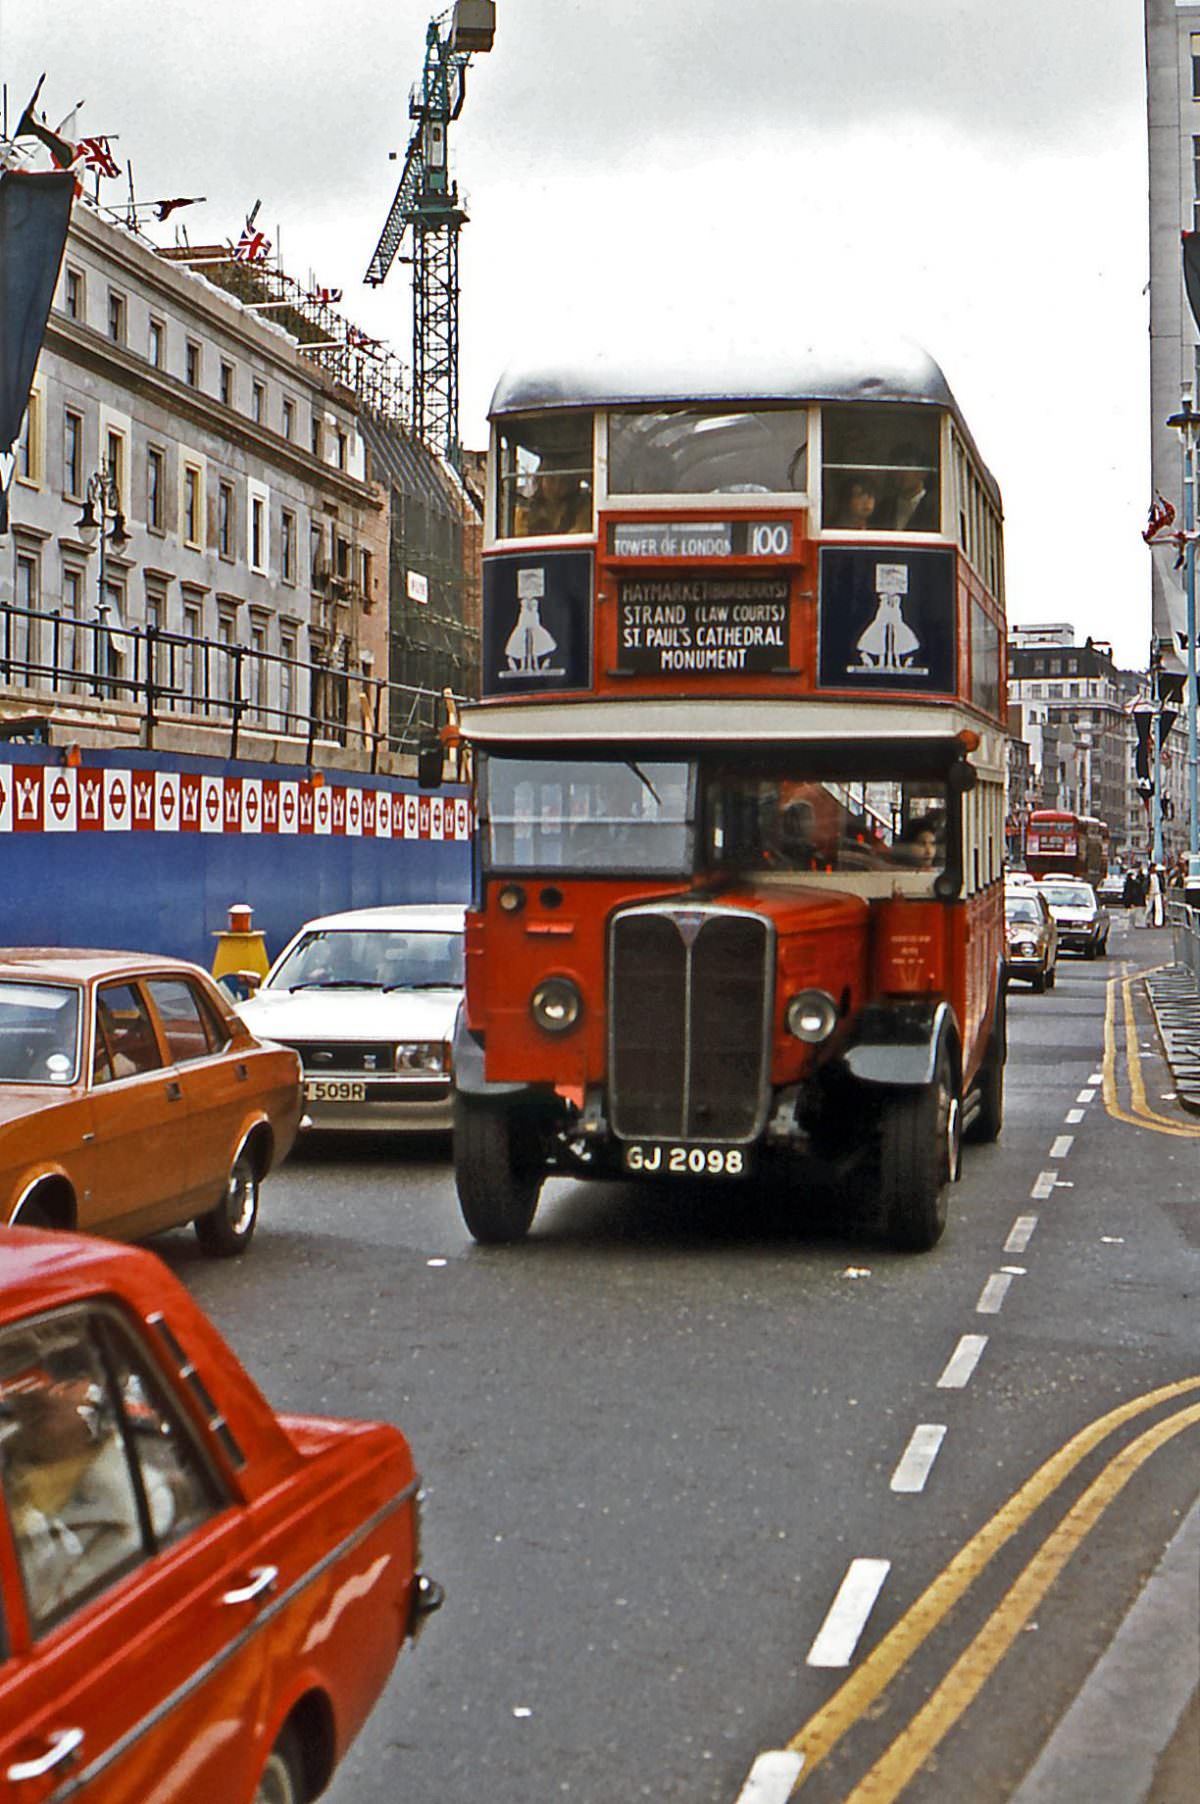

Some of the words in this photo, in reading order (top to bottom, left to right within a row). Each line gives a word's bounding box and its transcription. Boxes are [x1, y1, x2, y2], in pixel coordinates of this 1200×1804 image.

[614, 538, 657, 556] TOWER
[661, 538, 678, 556] OF
[681, 538, 732, 556] LONDON
[752, 526, 788, 555] 100
[623, 605, 686, 625] STRAND
[695, 605, 729, 623] (LAW
[733, 605, 786, 622] COURTS)
[646, 627, 691, 647] PAUL'S
[696, 626, 785, 647] CATHEDRAL
[660, 649, 747, 670] MONUMENT
[315, 1083, 363, 1099] 509R
[627, 1146, 662, 1171] GJ
[669, 1147, 743, 1174] 2098
